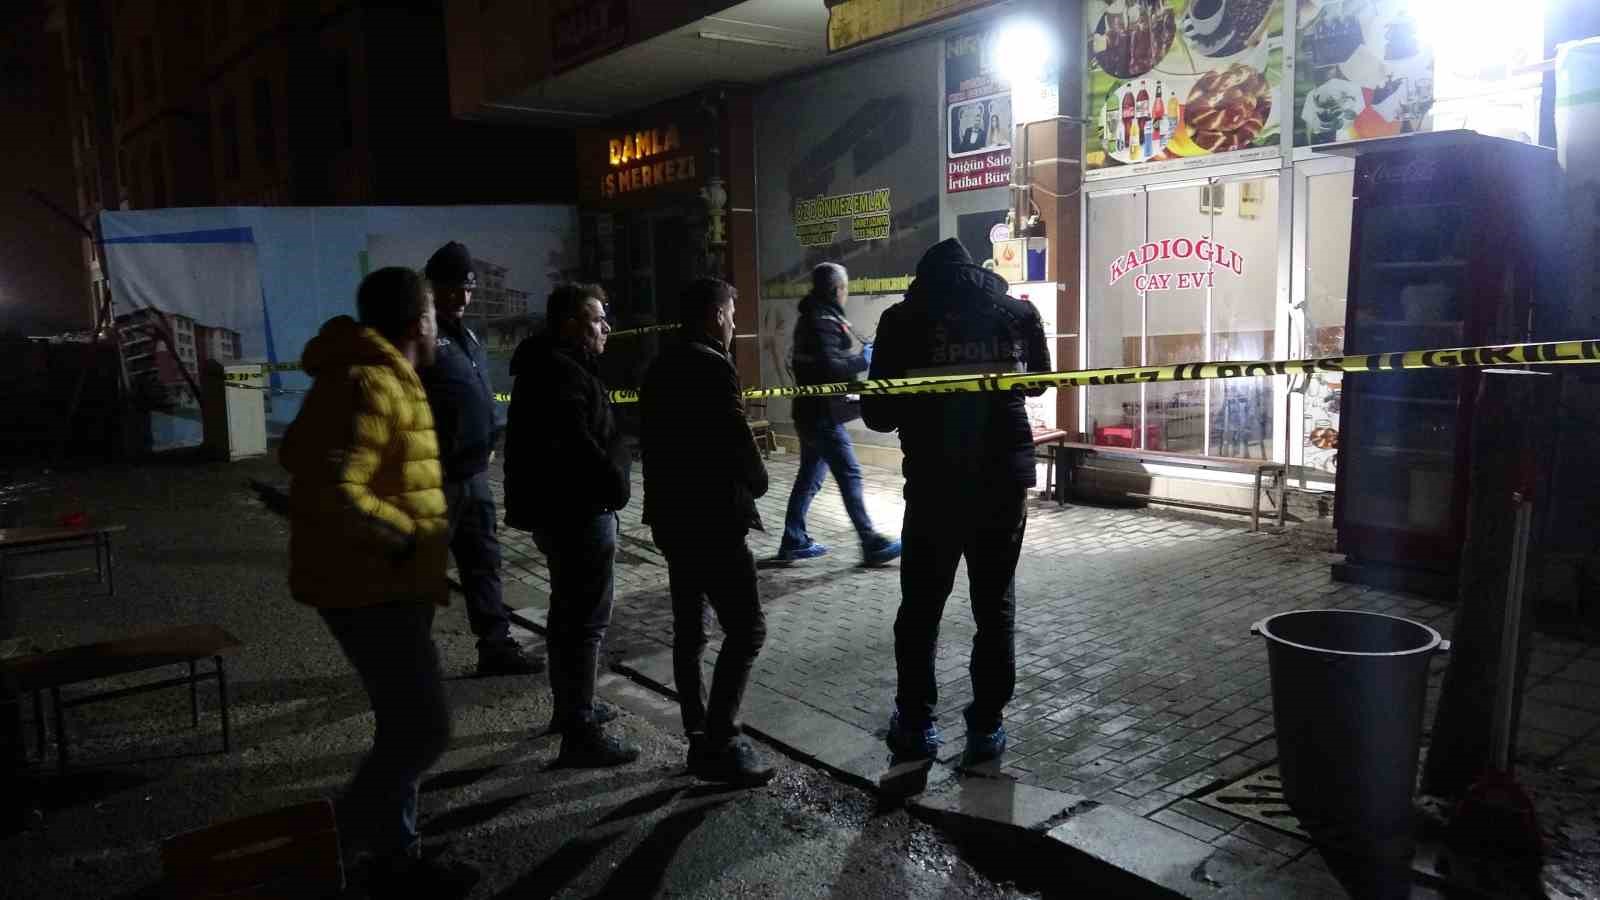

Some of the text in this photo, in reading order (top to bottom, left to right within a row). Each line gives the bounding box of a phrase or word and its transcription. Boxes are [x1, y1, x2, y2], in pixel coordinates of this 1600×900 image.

[608, 126, 681, 167] DAMLA
[948, 153, 1011, 174] Düğün Salo
[948, 175, 982, 190] İrtibat
[1110, 235, 1243, 282] KADIOĞLU
[1135, 273, 1171, 294] ÇAY
